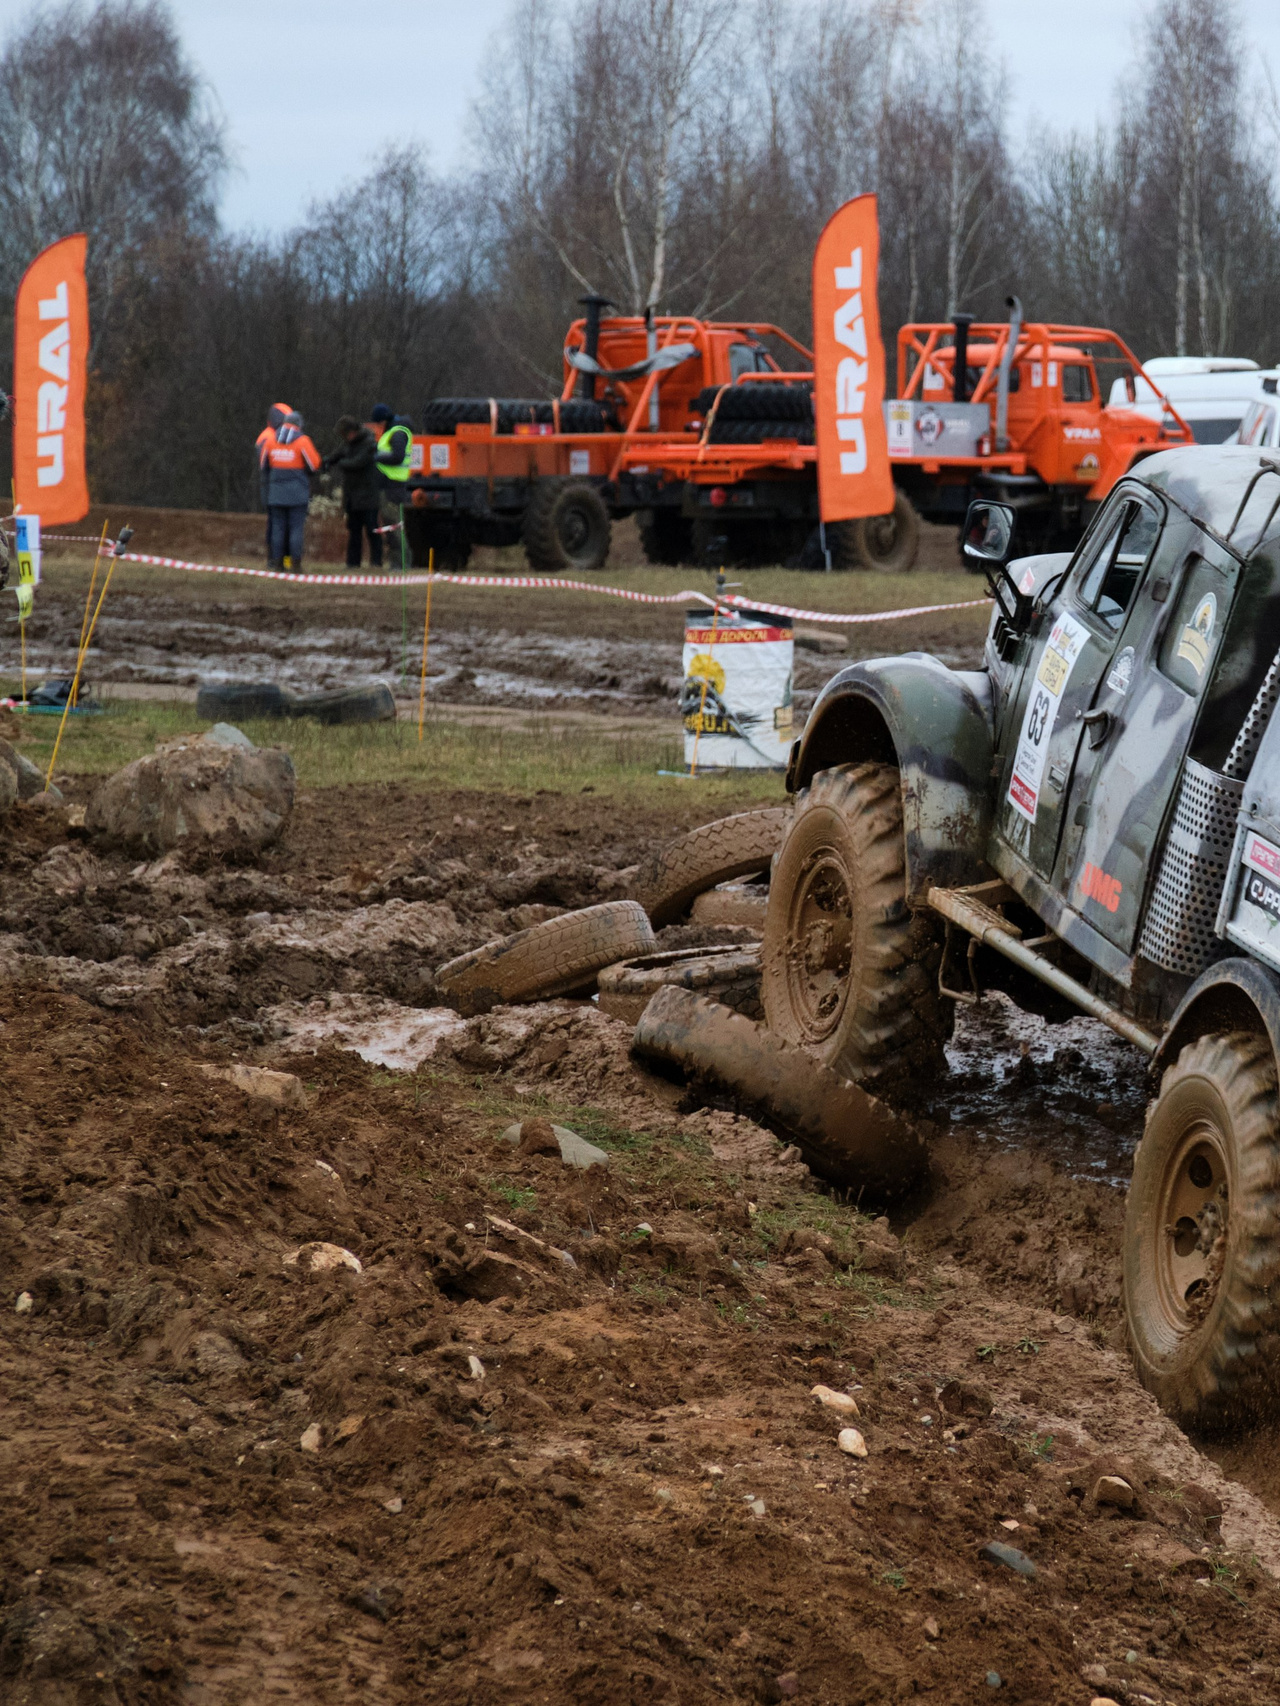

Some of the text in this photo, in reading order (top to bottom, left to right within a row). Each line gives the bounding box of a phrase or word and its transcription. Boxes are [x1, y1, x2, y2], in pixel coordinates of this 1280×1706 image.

[37, 280, 70, 487] URAL
[835, 247, 868, 475] URAL
[1028, 690, 1050, 746] 63
[1081, 862, 1122, 913] UMG
